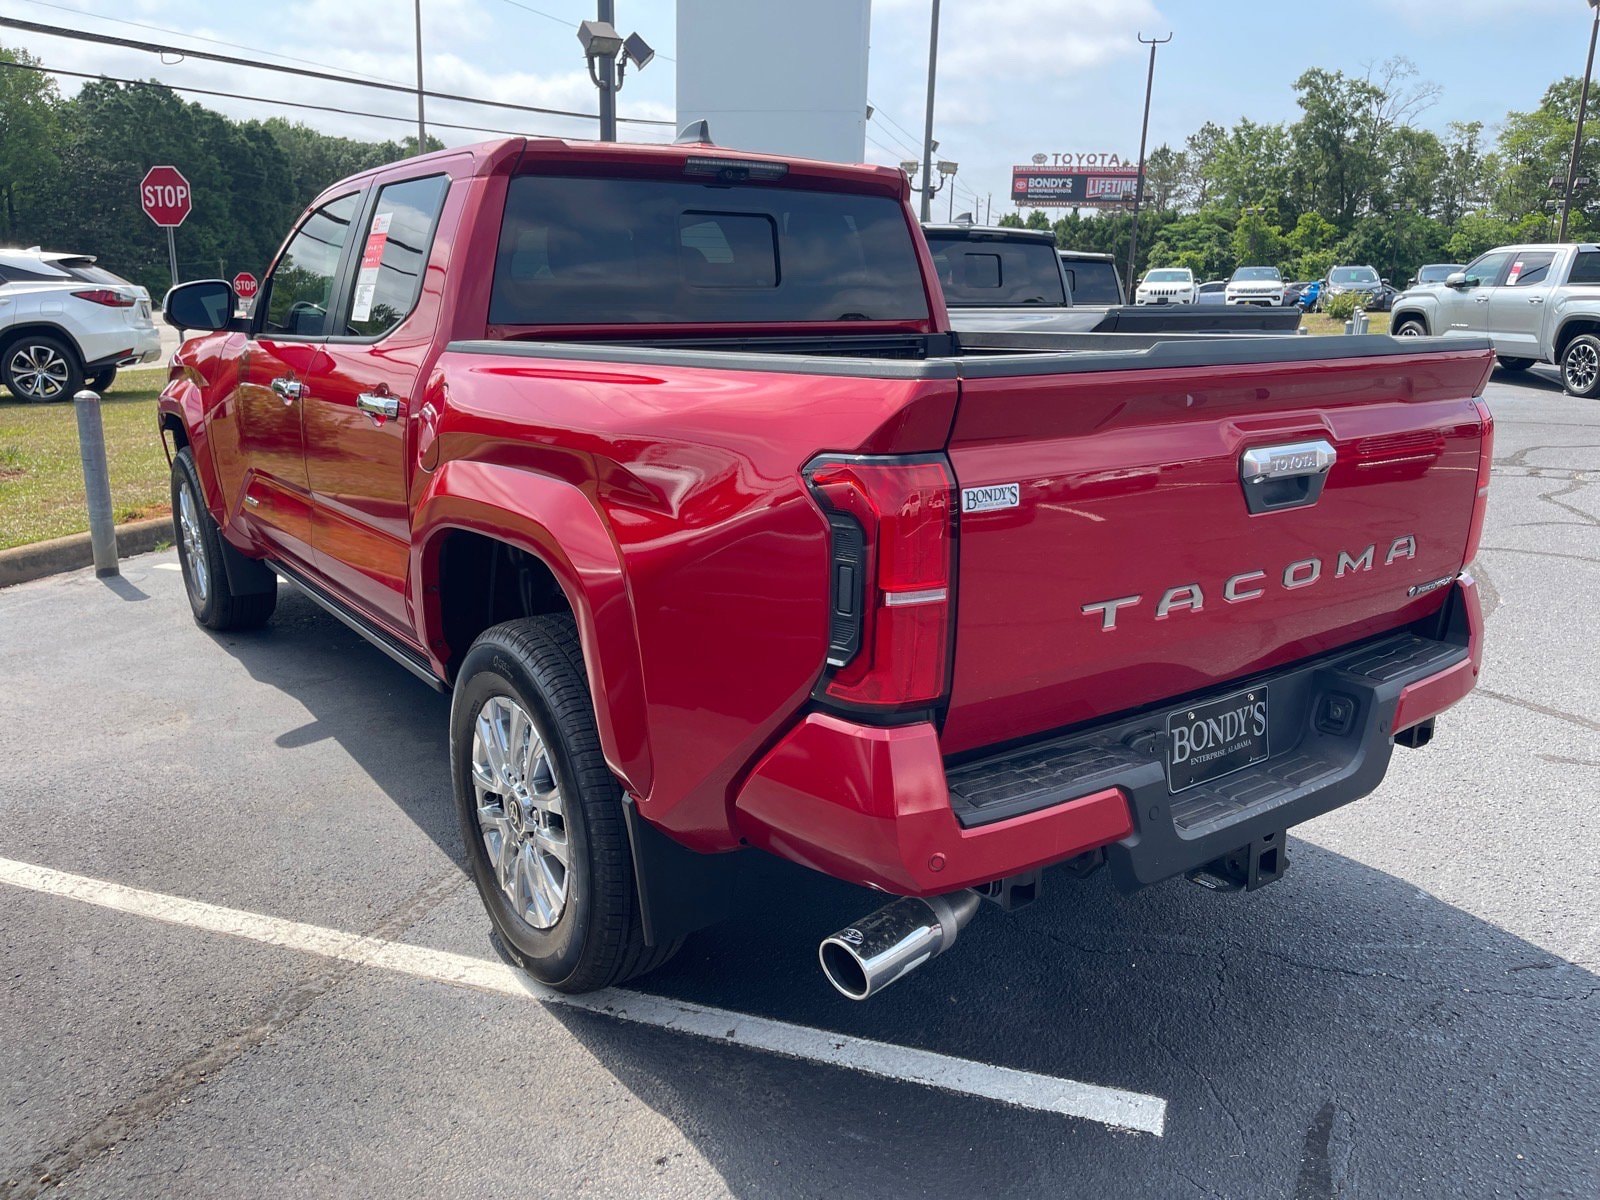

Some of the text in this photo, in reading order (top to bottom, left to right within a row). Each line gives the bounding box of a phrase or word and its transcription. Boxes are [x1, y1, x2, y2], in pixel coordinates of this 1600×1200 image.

[1052, 153, 1120, 165] TOYOTA
[1028, 178, 1073, 188] BONDY'S
[1088, 179, 1138, 195] LIFETIME
[144, 185, 187, 208] STOP
[235, 280, 256, 291] STOP
[1272, 455, 1315, 471] TOYOTA
[964, 485, 1018, 510] BONDY'S
[1081, 534, 1417, 631] TACOMA
[1171, 701, 1266, 765] BONDY'S
[1227, 739, 1252, 754] ALABAMA
